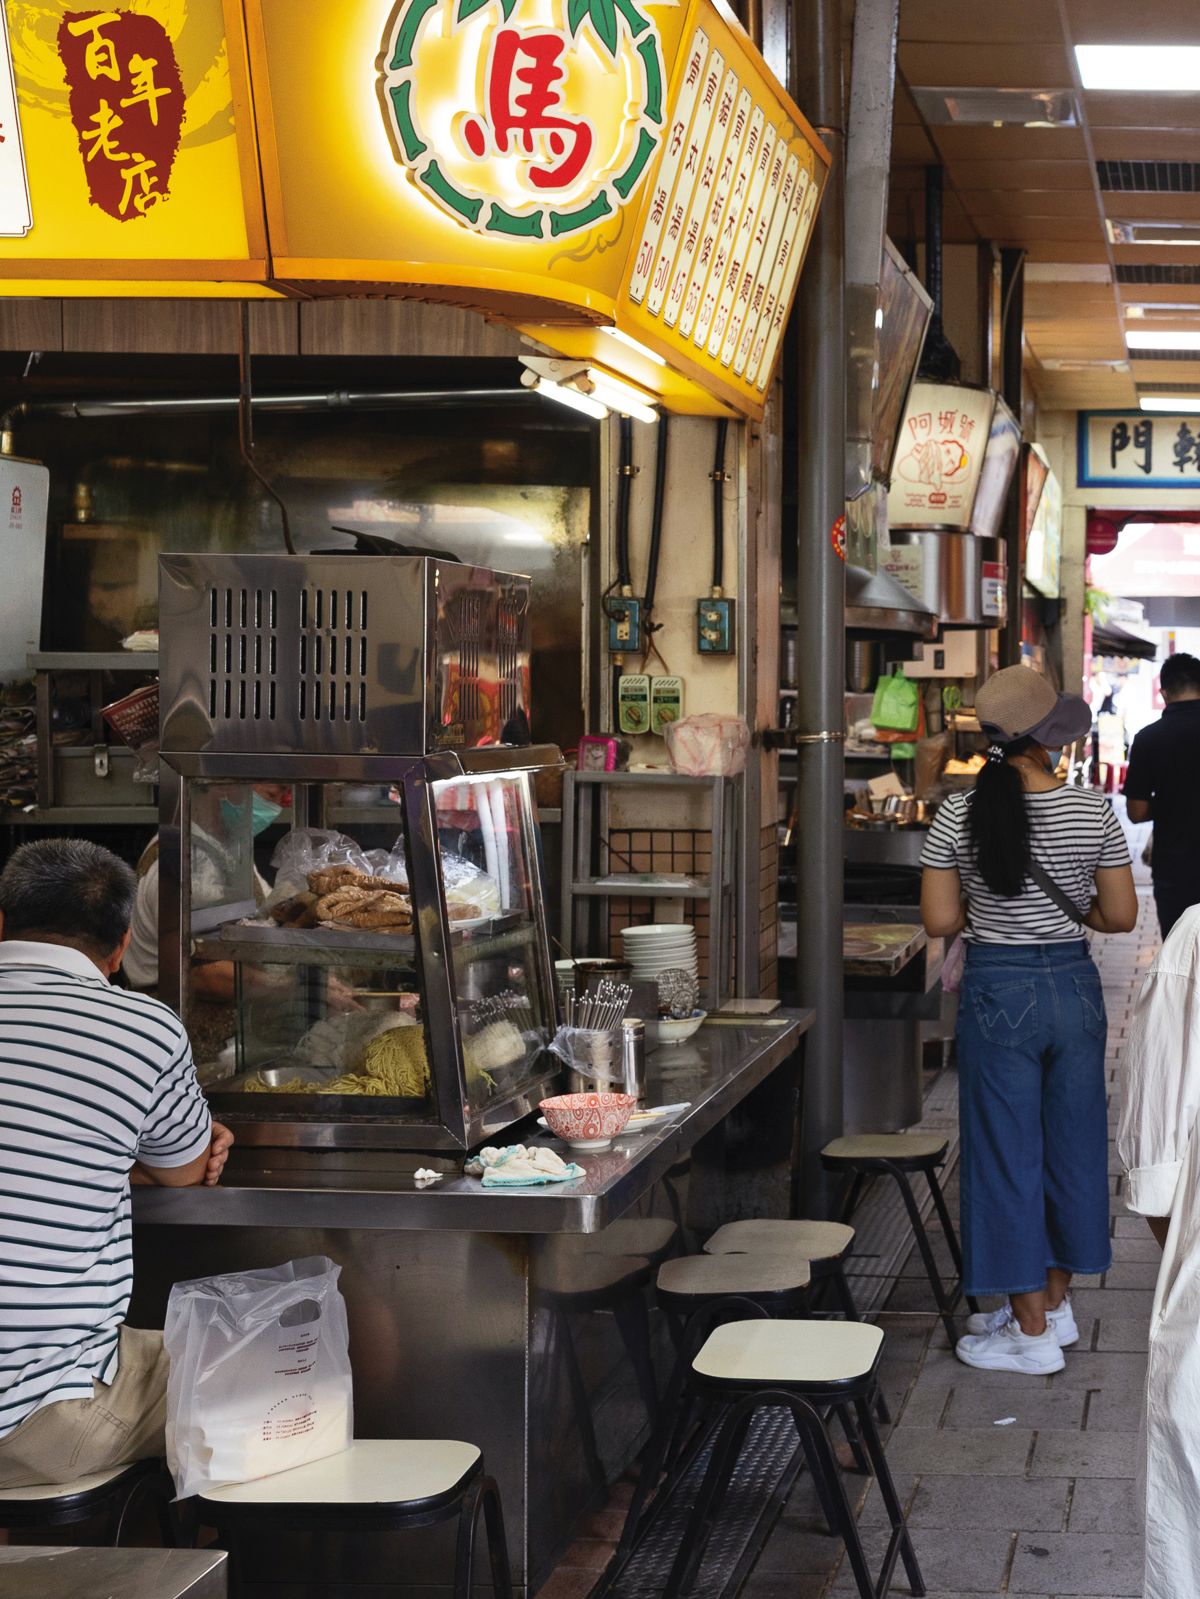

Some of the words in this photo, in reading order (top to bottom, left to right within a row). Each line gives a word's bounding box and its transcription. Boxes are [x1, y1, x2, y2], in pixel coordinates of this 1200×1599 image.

[67, 12, 172, 215] 百年老店
[465, 28, 592, 190] 馬
[653, 253, 671, 293] 50
